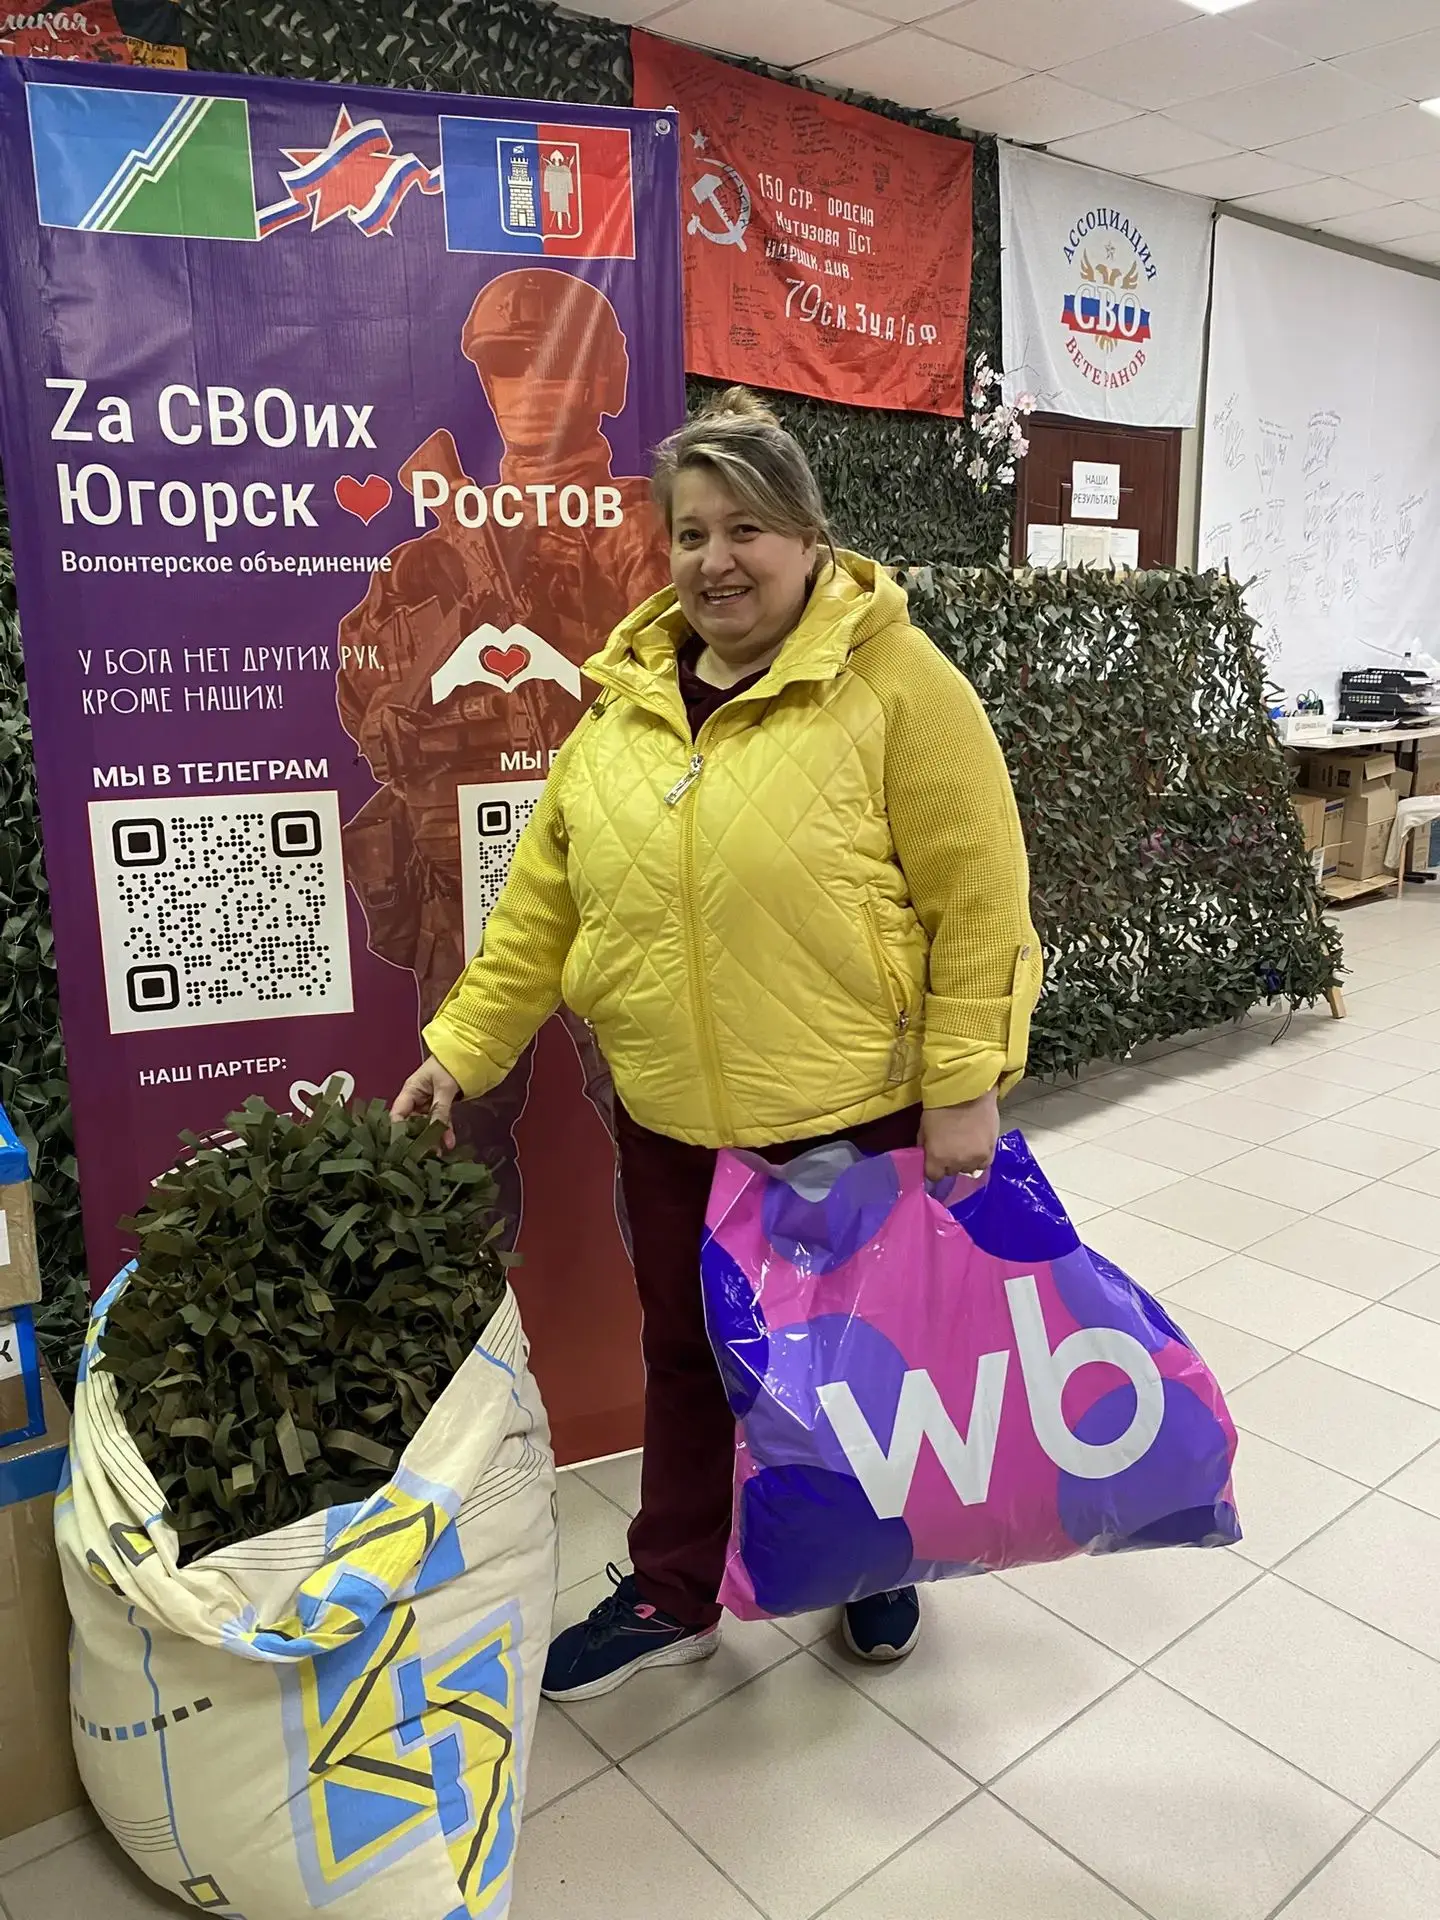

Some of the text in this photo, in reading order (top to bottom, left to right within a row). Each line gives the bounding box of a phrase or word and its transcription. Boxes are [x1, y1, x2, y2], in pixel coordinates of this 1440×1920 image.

[757, 172, 783, 203] 150
[789, 187, 817, 212] СТР.
[827, 197, 875, 227] ОРДЕНА
[1063, 207, 1158, 281] АССОЦИАЦИЯ
[824, 259, 854, 281] ДИВ.
[1073, 283, 1141, 338] СВО
[1065, 335, 1147, 390] ВЕТЕРАНОВ
[158, 384, 378, 449] СВОих
[1085, 474, 1109, 486] НАШИ
[56, 463, 625, 543] Югорск Ростов
[61, 550, 393, 578] Волонтерское объединение
[78, 645, 385, 675] У БОГА НЕТ ДРУГИХ РУК,
[82, 684, 284, 715] КРОМЕ НАШИХ!
[92, 758, 329, 788] МЫ В ТЕЛЕГРАМ
[500, 750, 542, 772] МЫ
[139, 1056, 287, 1086] НАШ ПАРТЕР:
[816, 1274, 1165, 1520] wb
